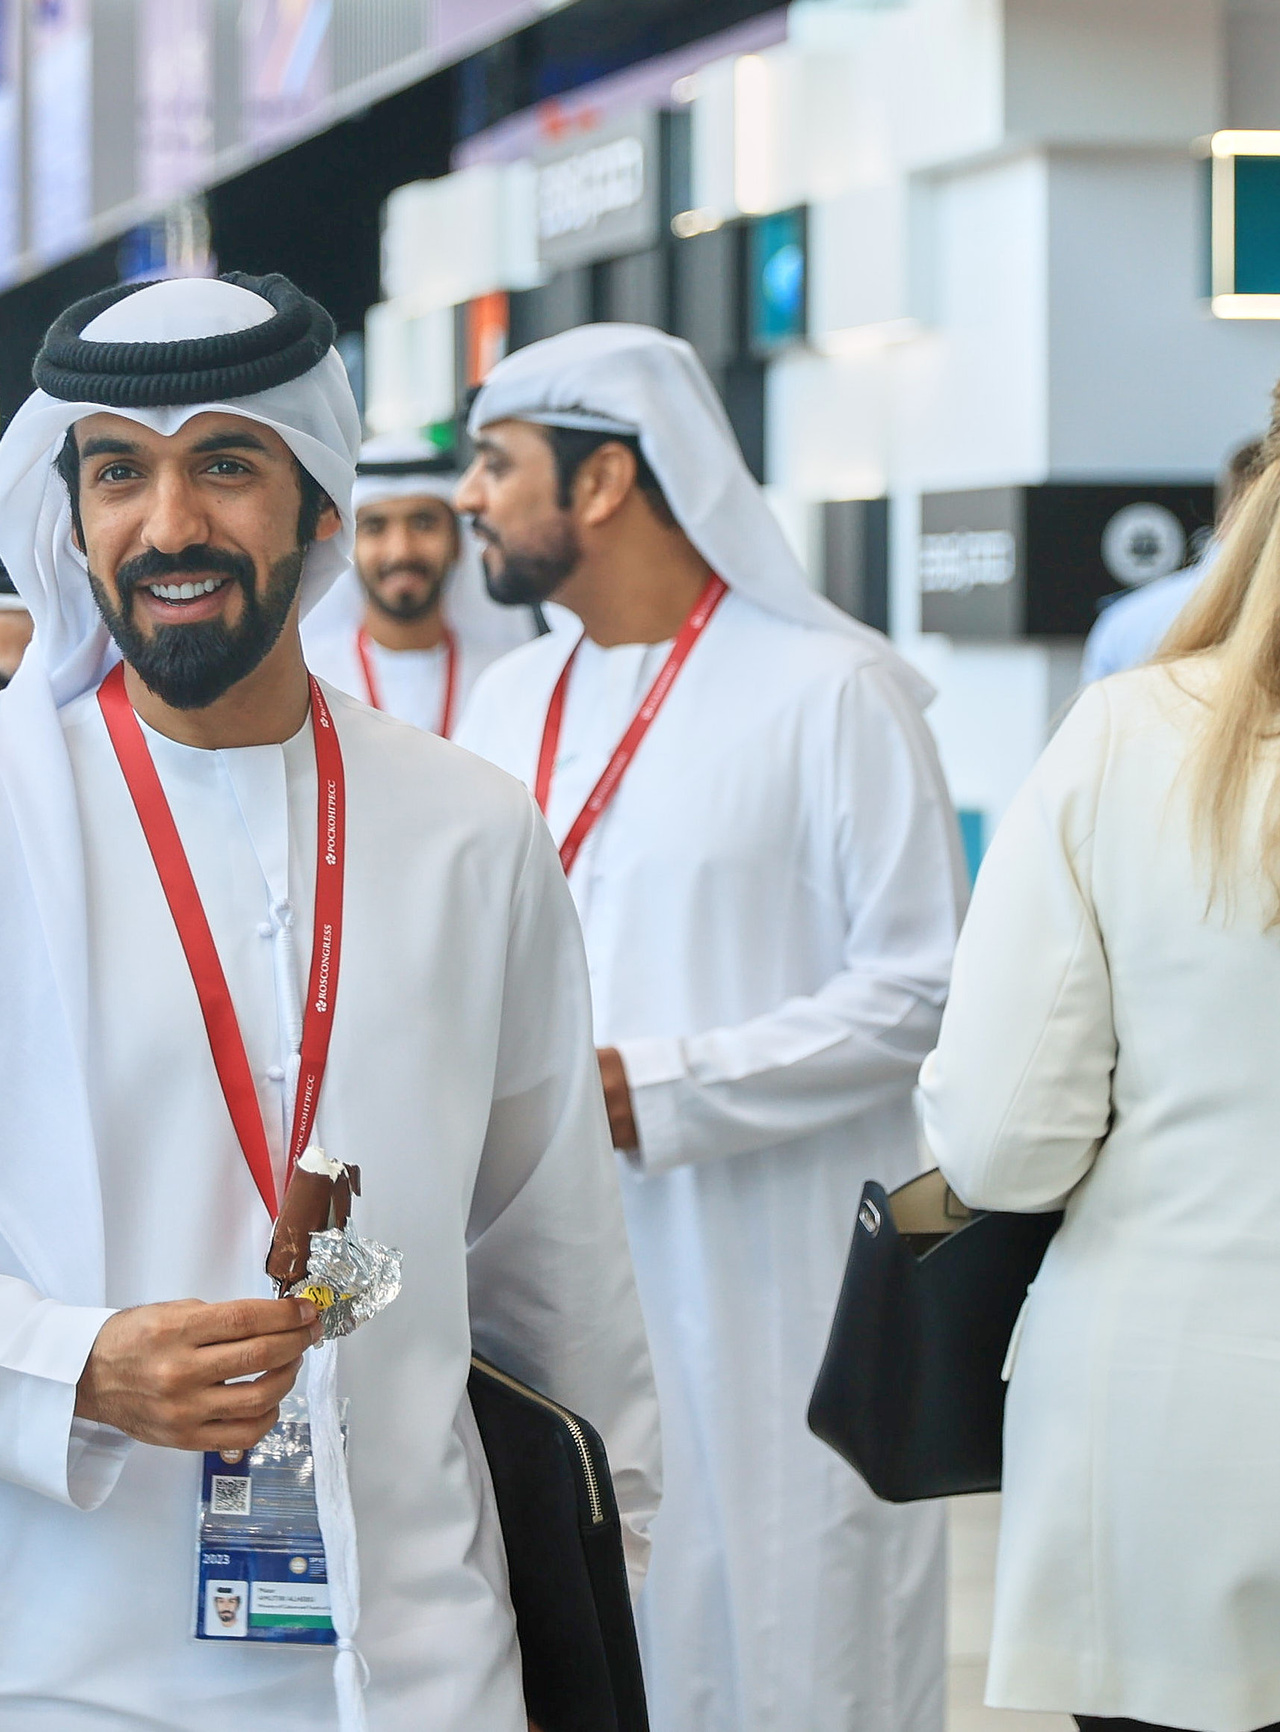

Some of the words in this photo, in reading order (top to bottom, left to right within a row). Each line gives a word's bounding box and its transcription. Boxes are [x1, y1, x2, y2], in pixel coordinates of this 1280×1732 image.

[327, 779, 336, 853] РОСКОНГРЕСС
[318, 924, 332, 1000] ROSCONGRESS
[202, 1553, 231, 1565] 2023
